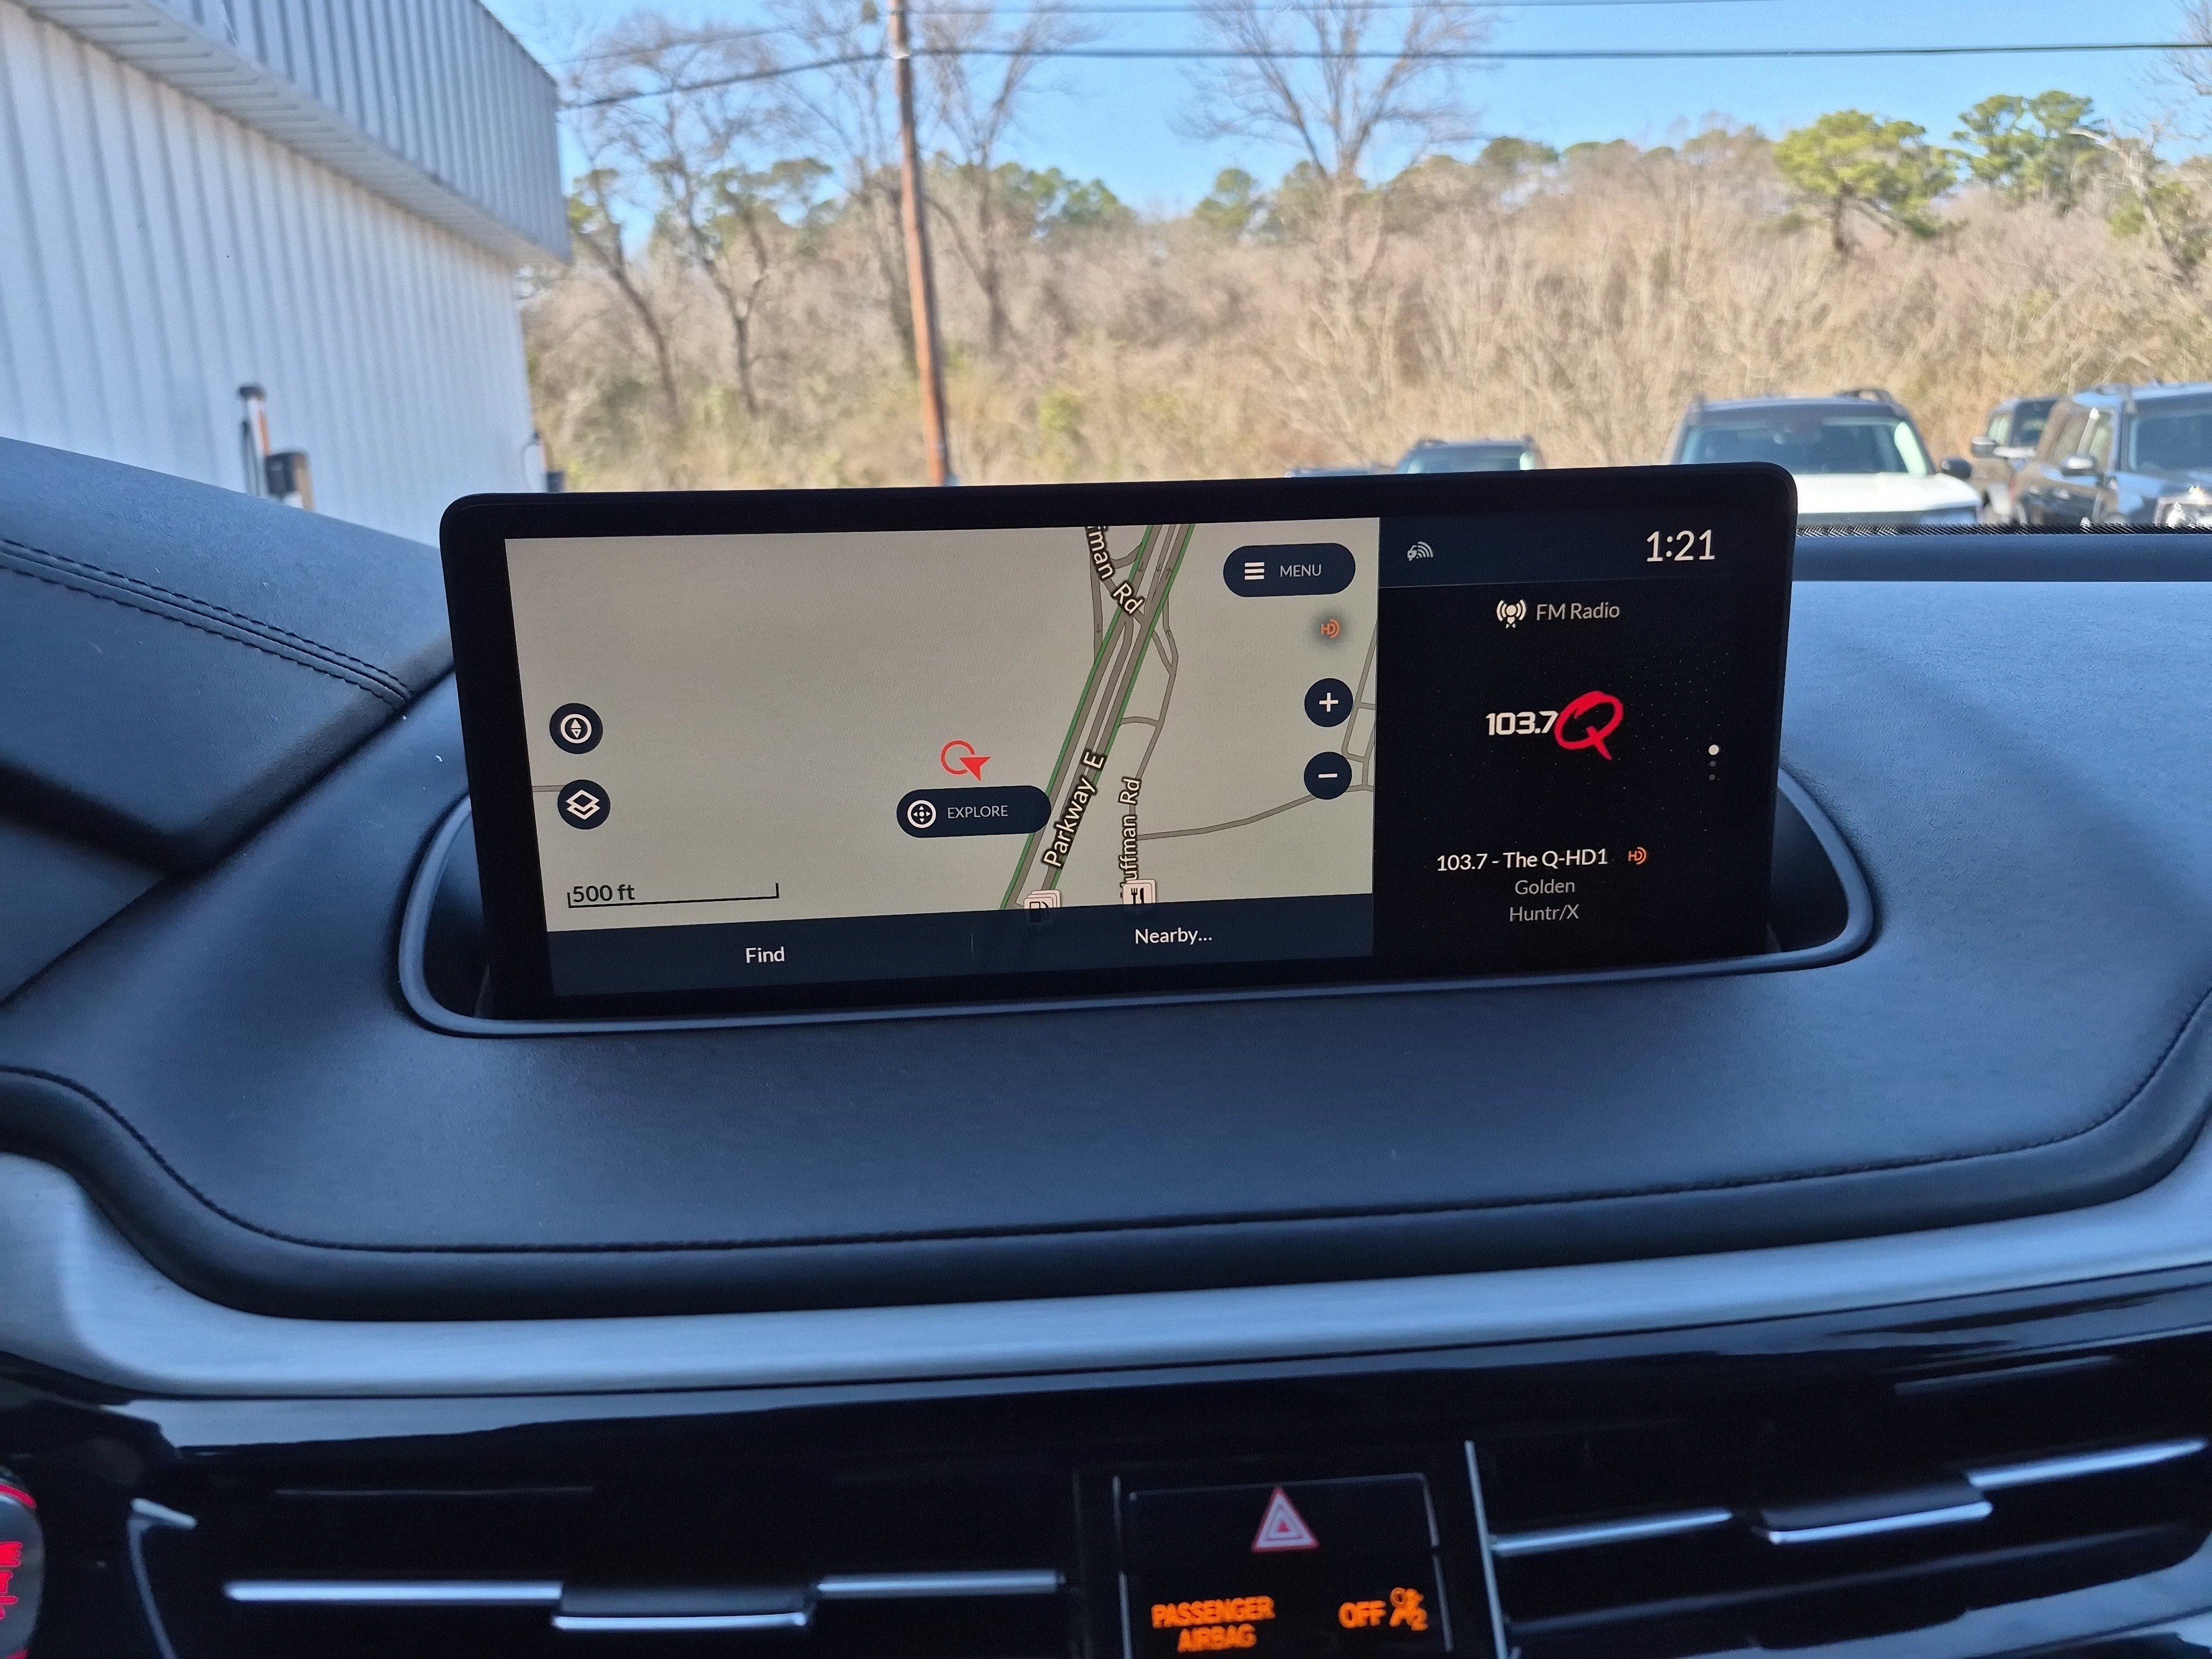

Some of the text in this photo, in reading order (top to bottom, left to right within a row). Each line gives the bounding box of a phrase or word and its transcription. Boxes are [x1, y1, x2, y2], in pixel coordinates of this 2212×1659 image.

[1646, 529, 1715, 562] 1:21
[1087, 526, 1143, 614] man Rd
[1280, 564, 1322, 578] MENU
[1536, 602, 1620, 621] FM Radio
[1486, 710, 1558, 736] 103.7
[947, 805, 1009, 820] EXPLORE
[1043, 751, 1104, 867] Parkway E
[1120, 779, 1140, 885] uffman Rd
[1437, 853, 1488, 871] 103.7
[1503, 852, 1538, 868] The
[1542, 848, 1608, 869] Q-HD1
[573, 883, 635, 903] 500 ft
[1515, 878, 1576, 895] Golden
[1509, 904, 1579, 922] Huntr/X
[1135, 927, 1212, 945] Nearby...
[746, 946, 785, 964] Find
[1151, 1596, 1275, 1628] PASSENGER
[1339, 1600, 1386, 1628] OFF
[1177, 1623, 1257, 1652] AIRBAG
